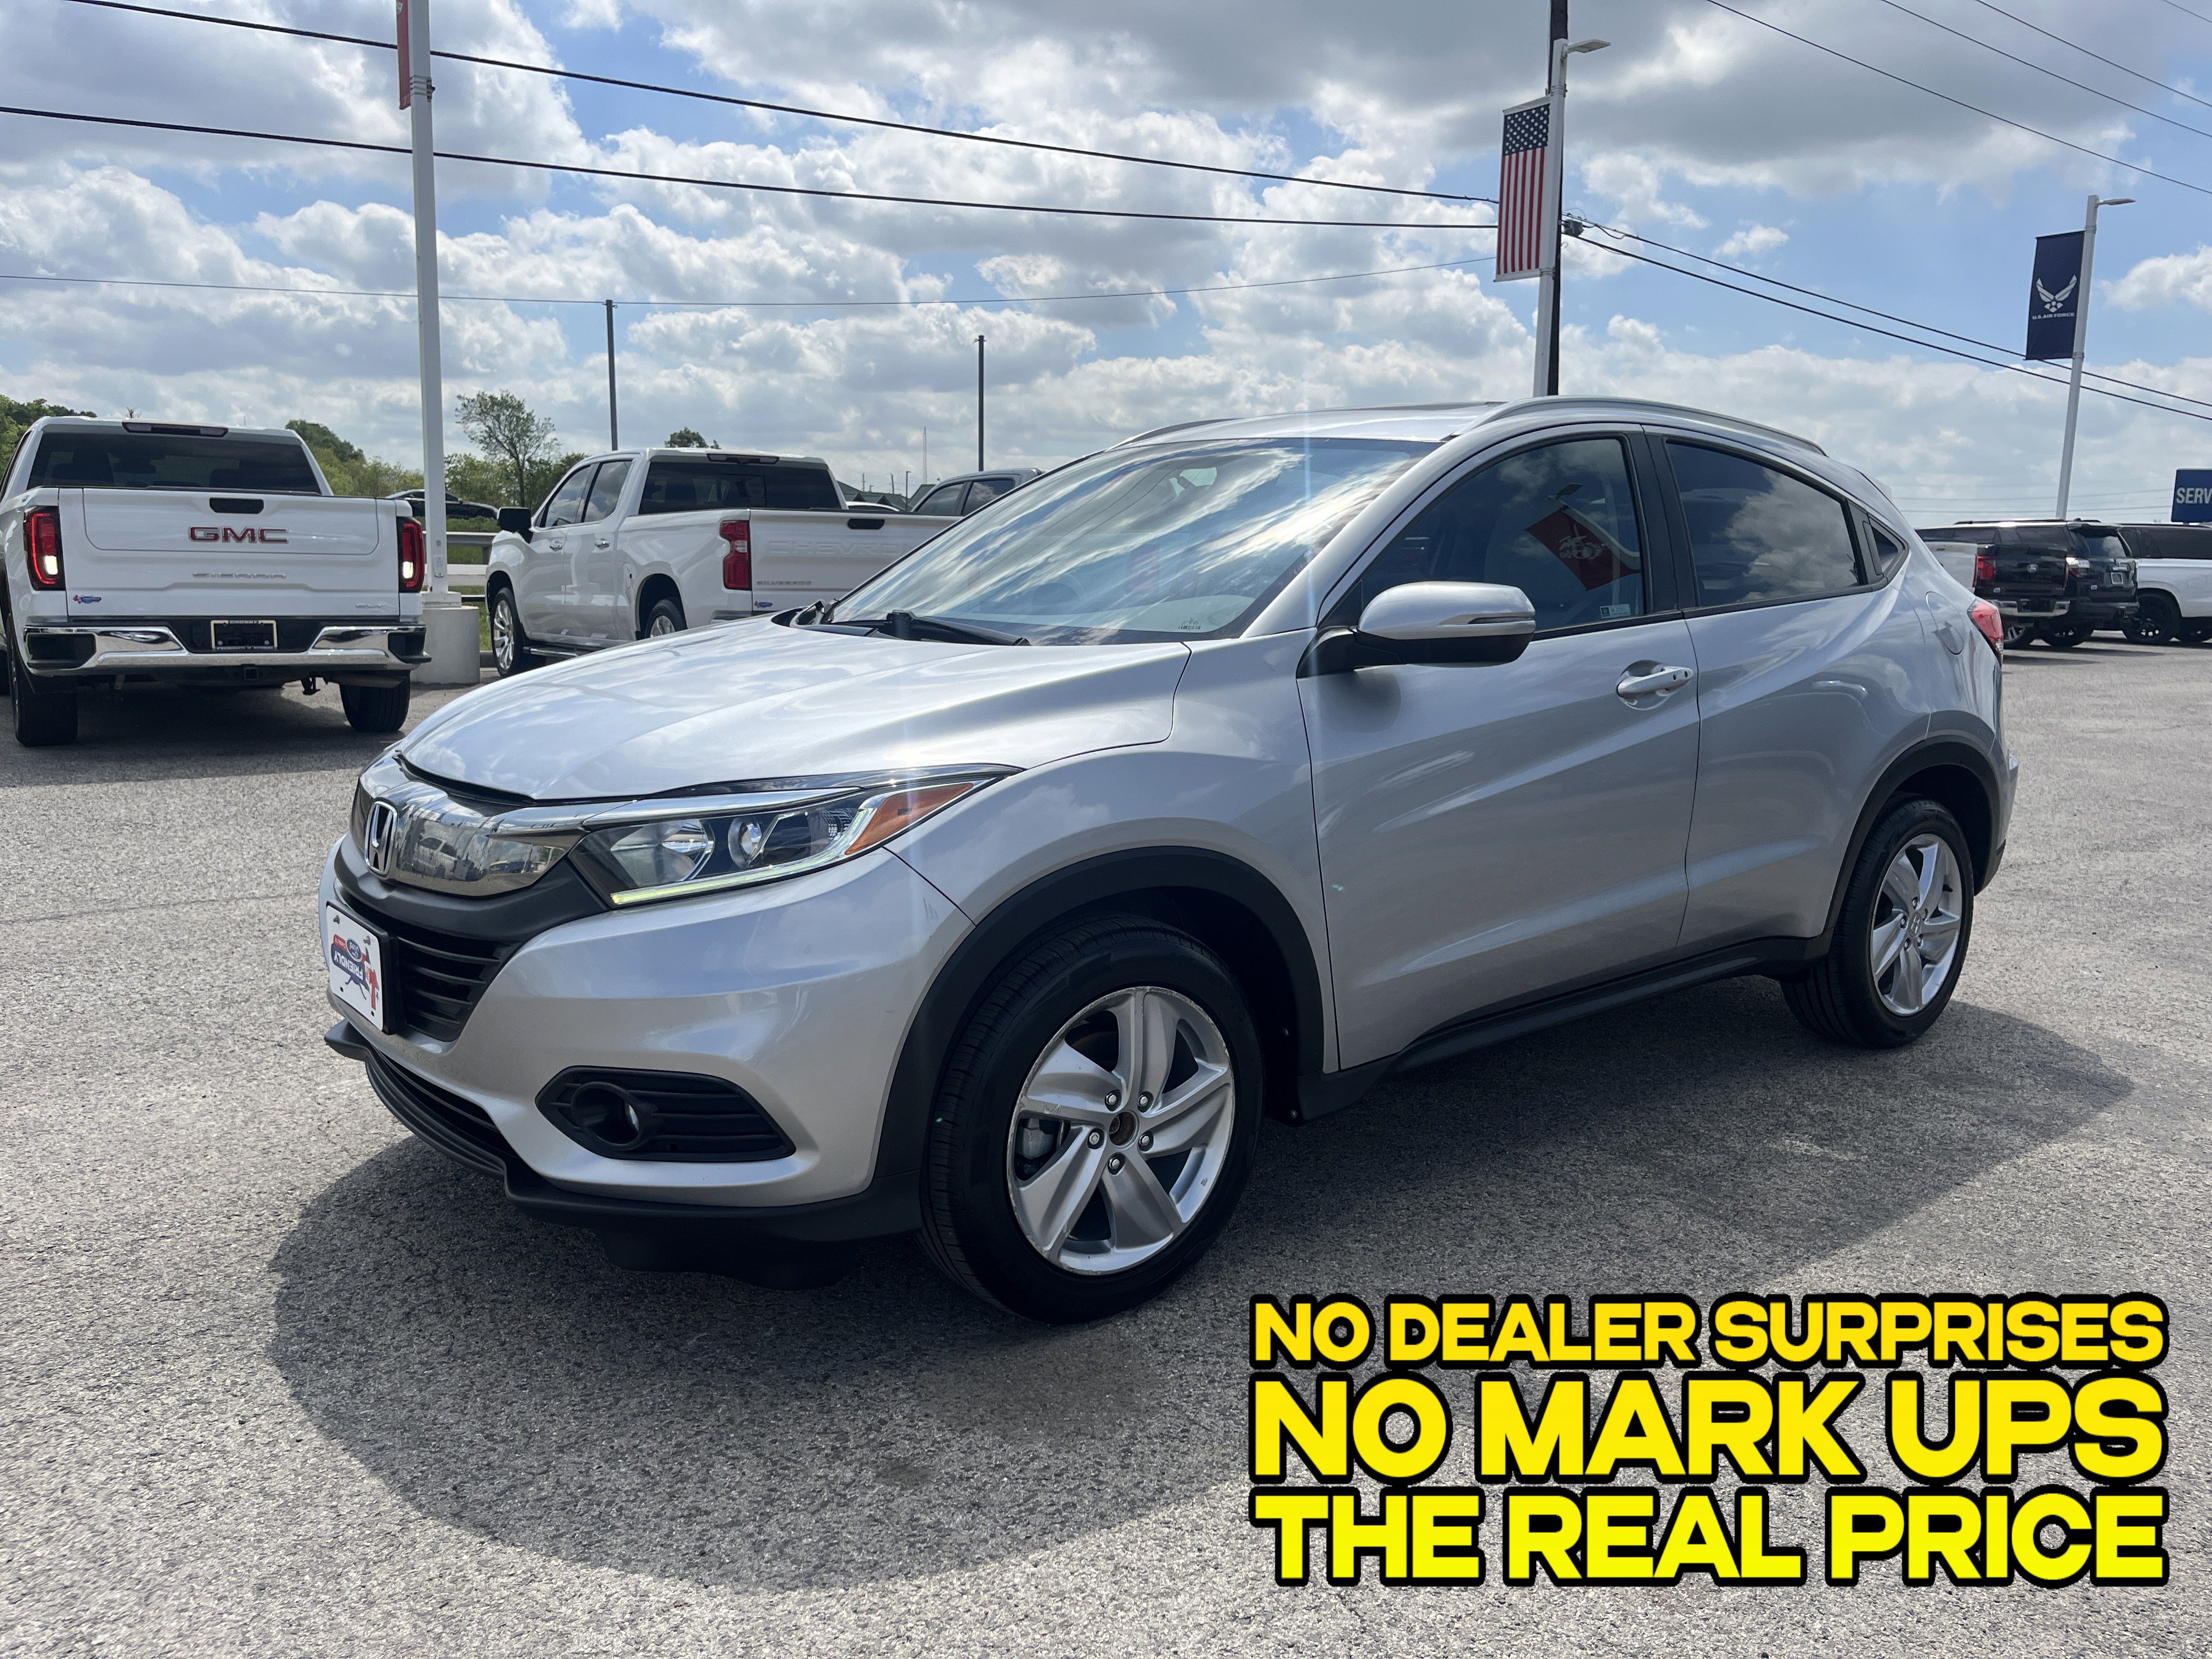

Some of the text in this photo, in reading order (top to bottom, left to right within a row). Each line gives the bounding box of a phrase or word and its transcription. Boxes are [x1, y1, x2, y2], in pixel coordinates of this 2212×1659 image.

[2176, 486, 2212, 504] SERV
[189, 526, 289, 544] GMC
[334, 950, 363, 980] FRIENDLY
